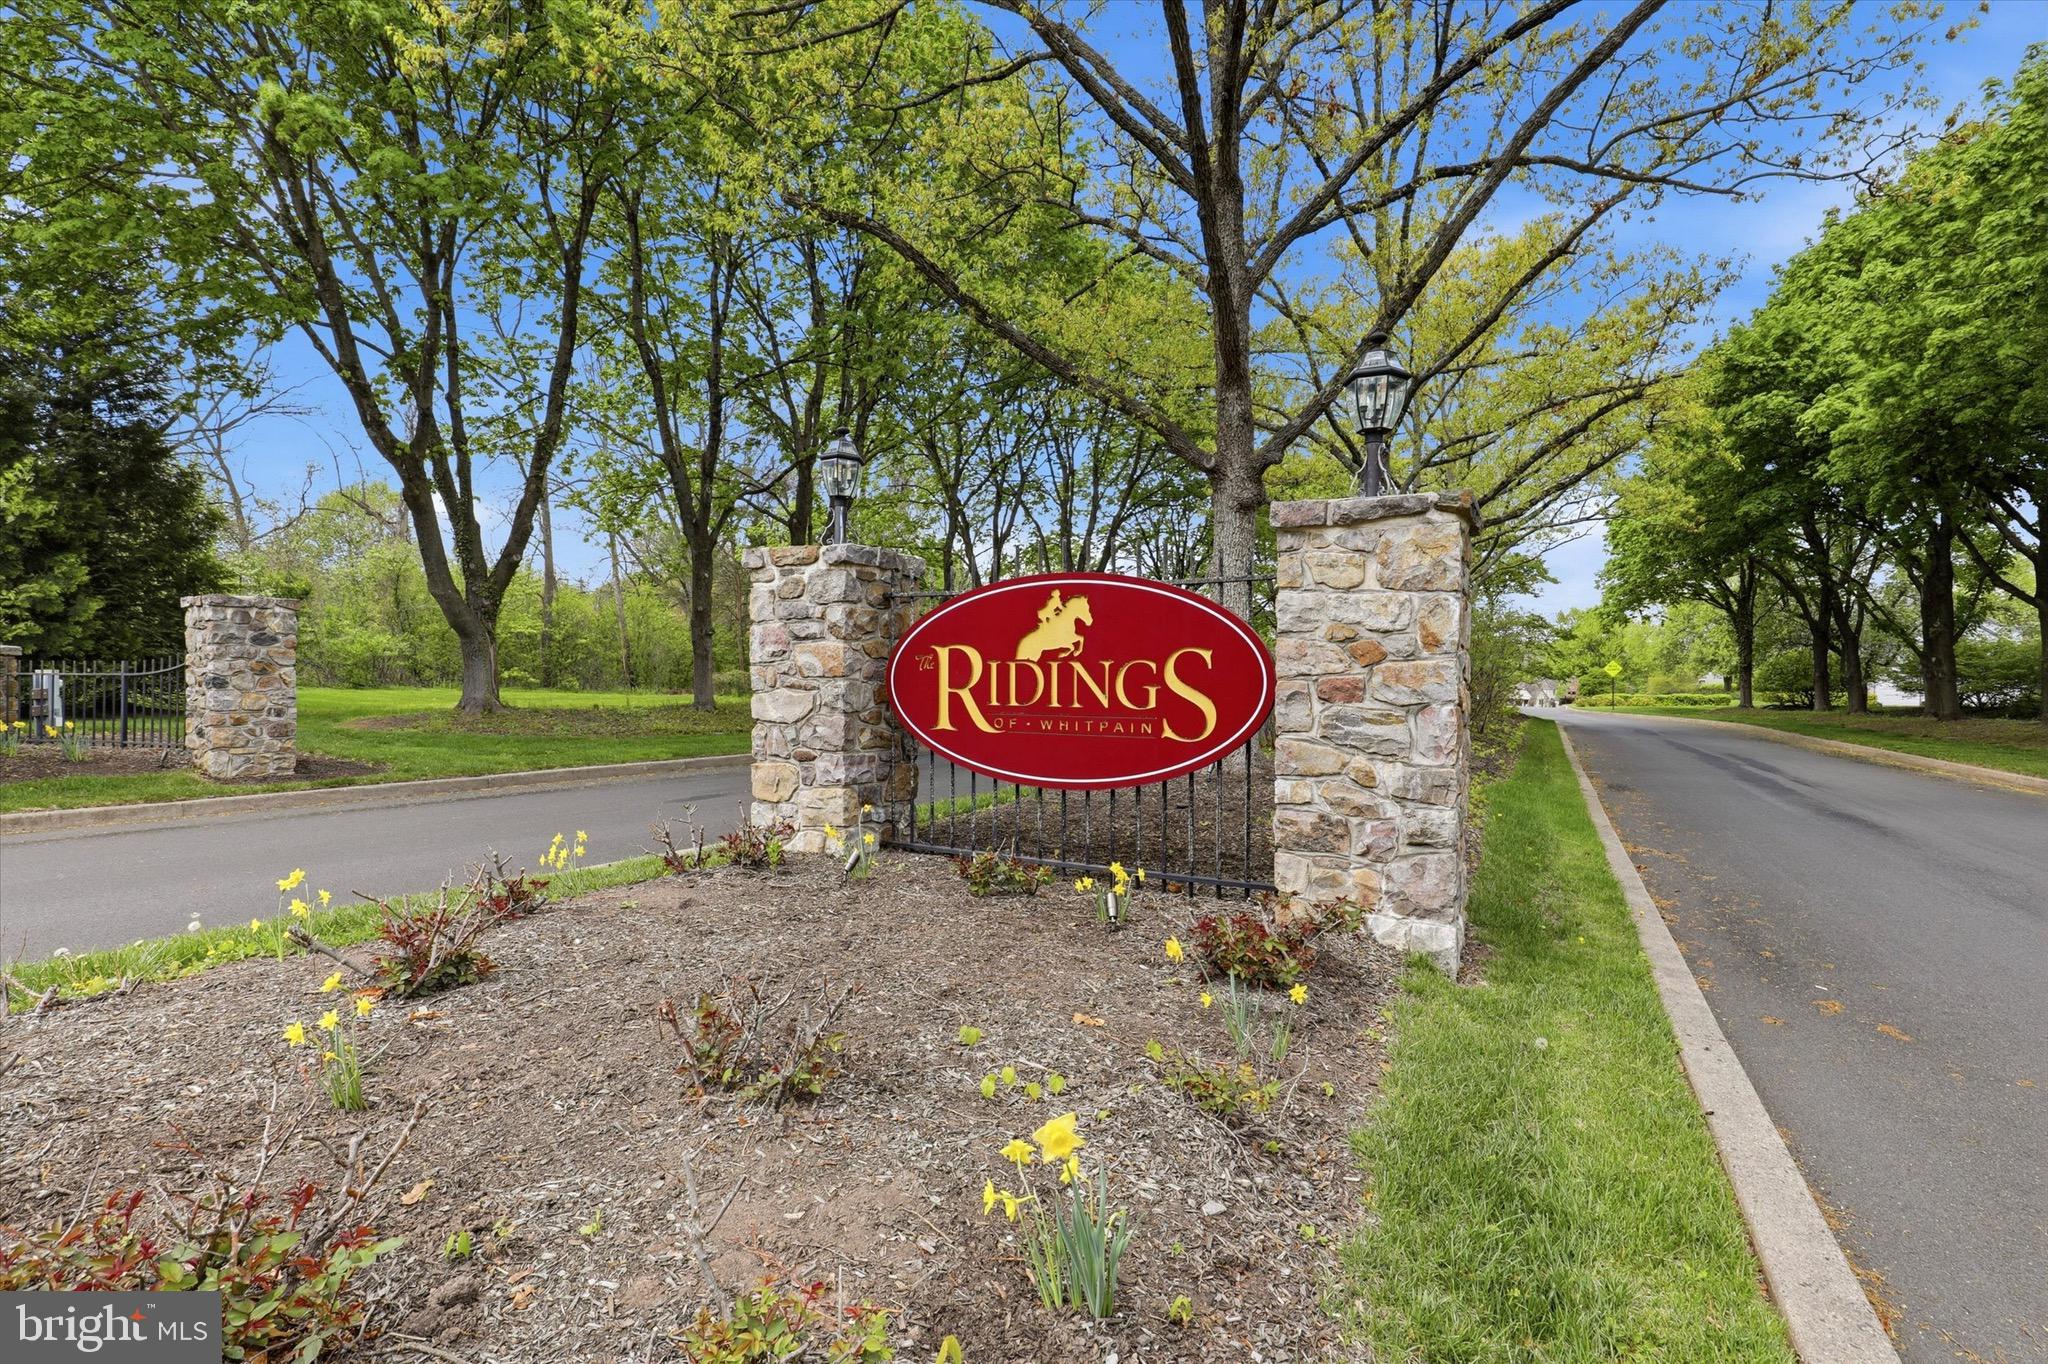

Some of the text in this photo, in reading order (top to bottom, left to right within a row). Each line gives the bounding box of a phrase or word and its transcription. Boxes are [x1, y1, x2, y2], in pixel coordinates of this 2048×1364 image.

[915, 644, 1218, 743] The RIDINGS
[993, 717, 1153, 735] OF WHITPAIN
